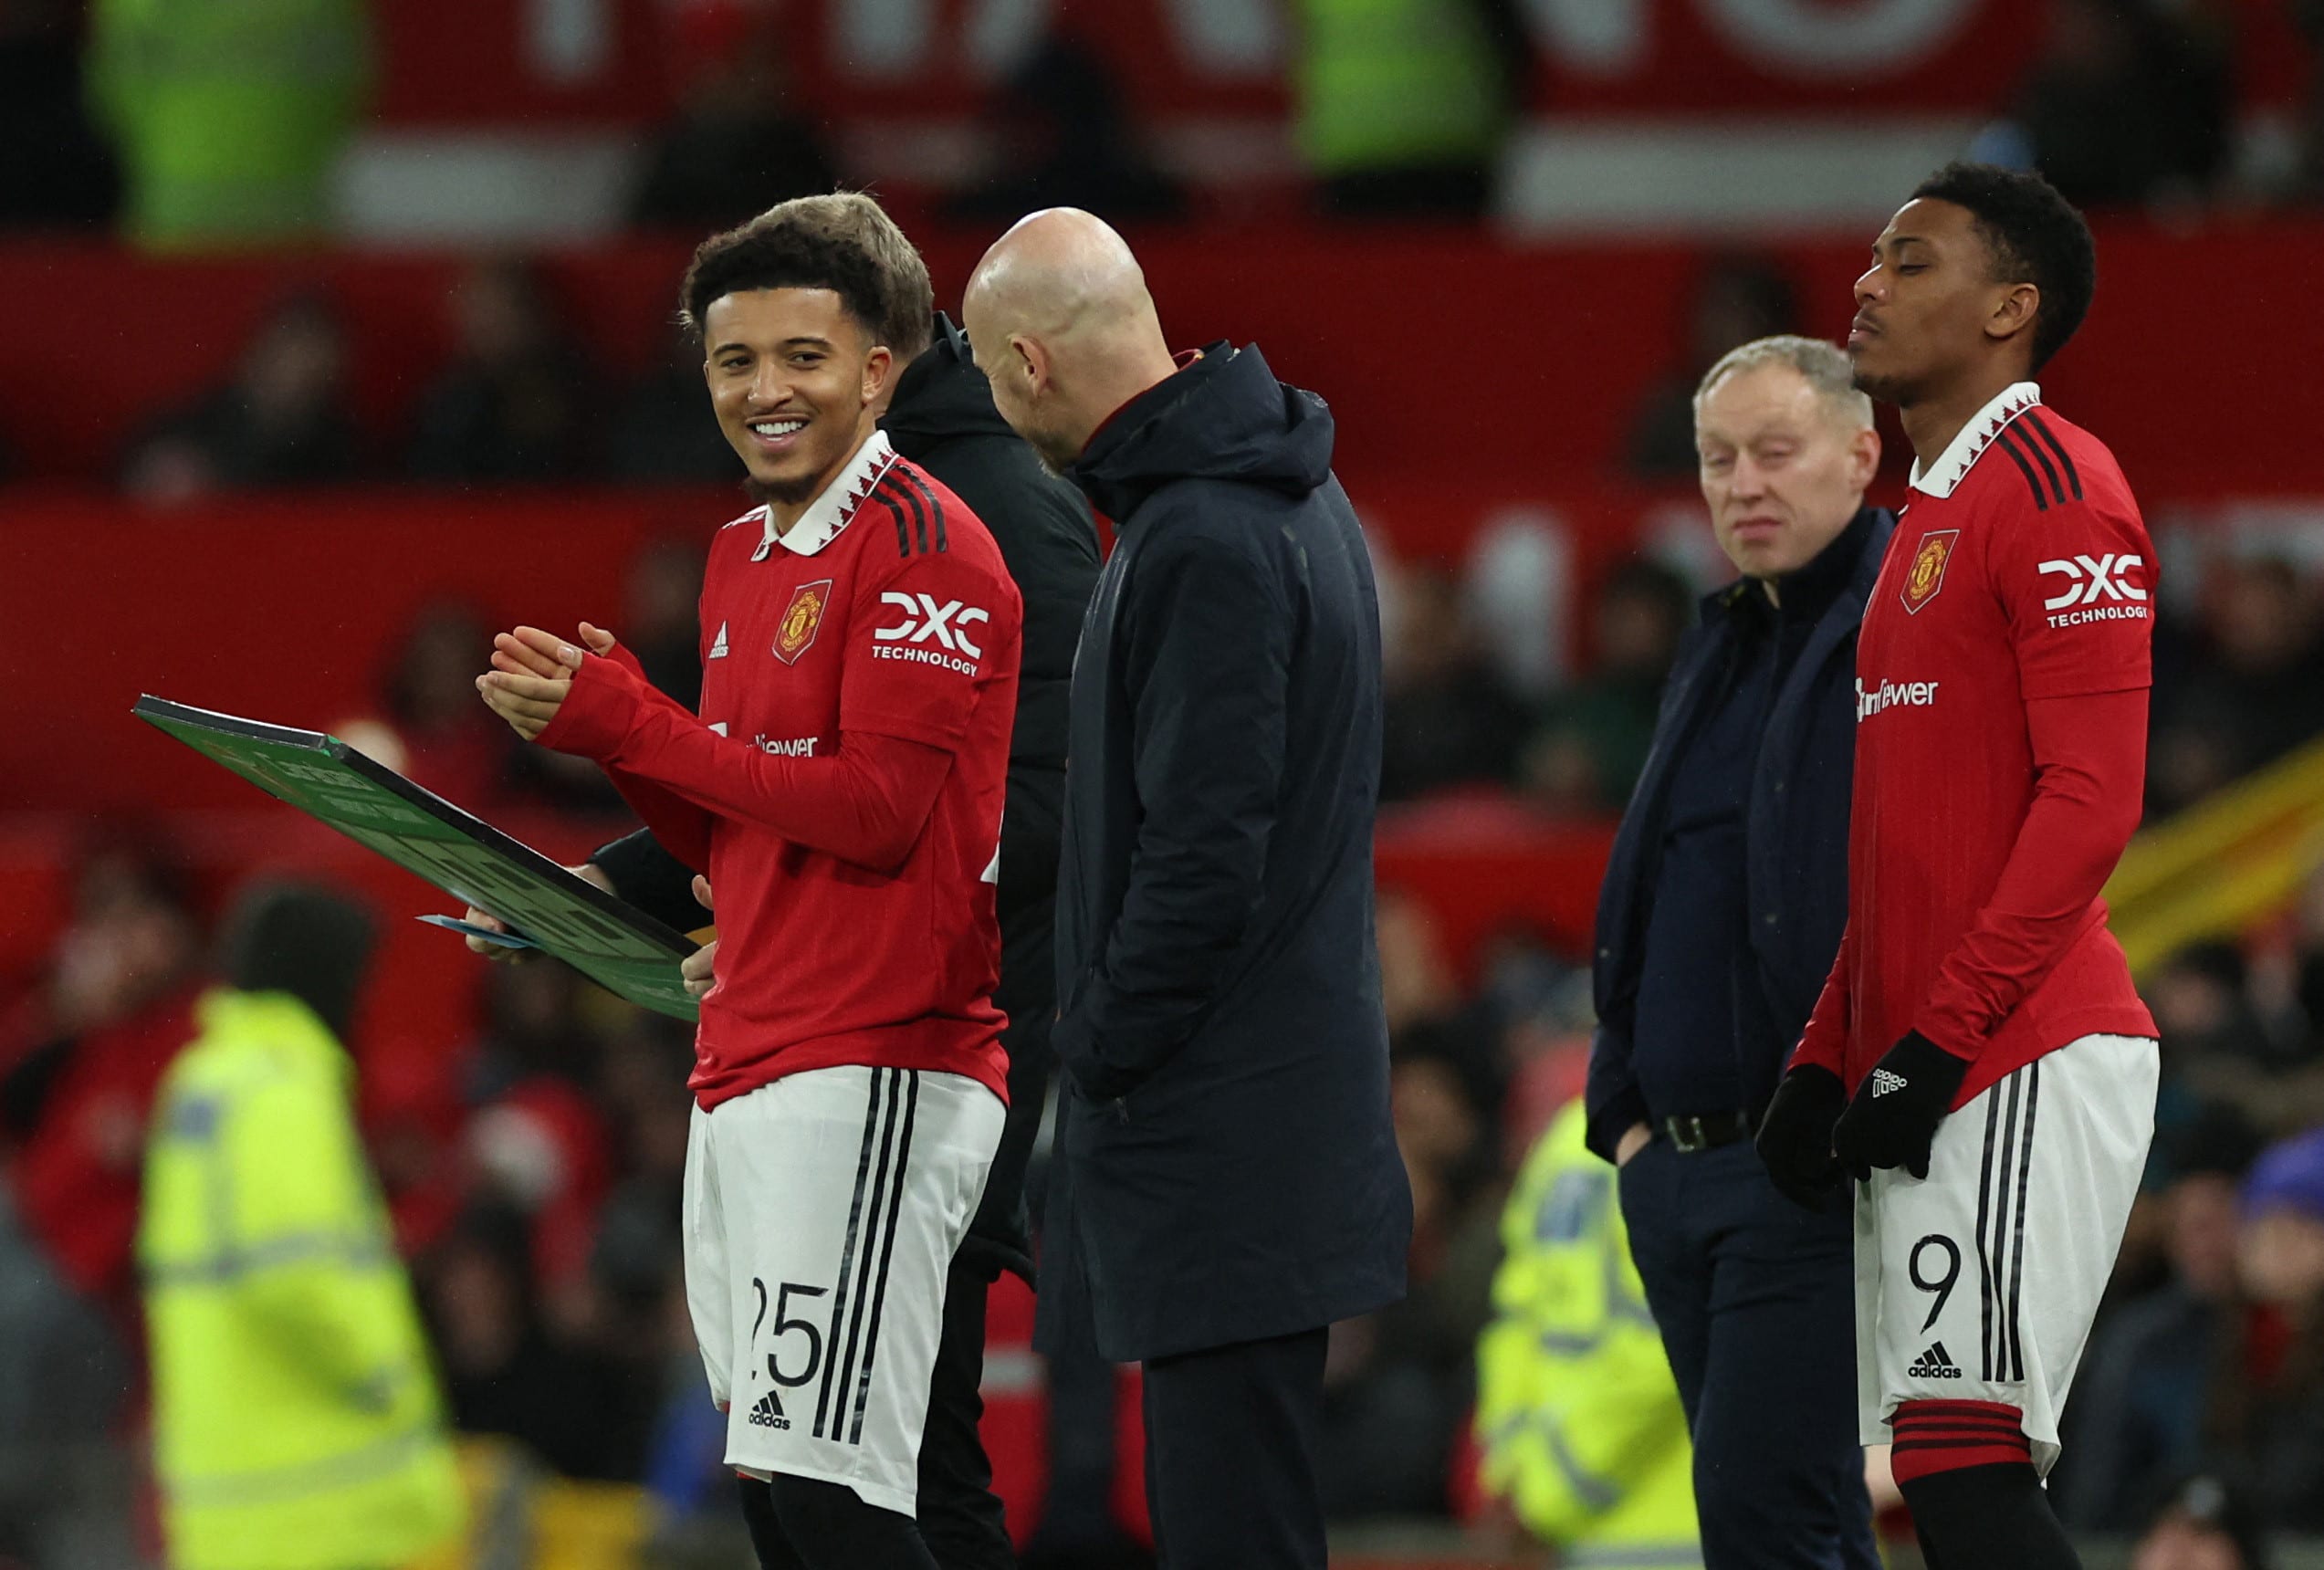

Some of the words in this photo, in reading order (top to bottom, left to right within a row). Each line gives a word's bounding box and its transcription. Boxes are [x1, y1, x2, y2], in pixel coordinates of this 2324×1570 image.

[2038, 553, 2147, 611] DXC
[874, 591, 989, 659] DXC
[872, 644, 978, 677] TECHNOLOGY
[1909, 1234, 1962, 1335] 9
[1908, 1366, 1962, 1379] adidas
[748, 1411, 791, 1430] adidas
